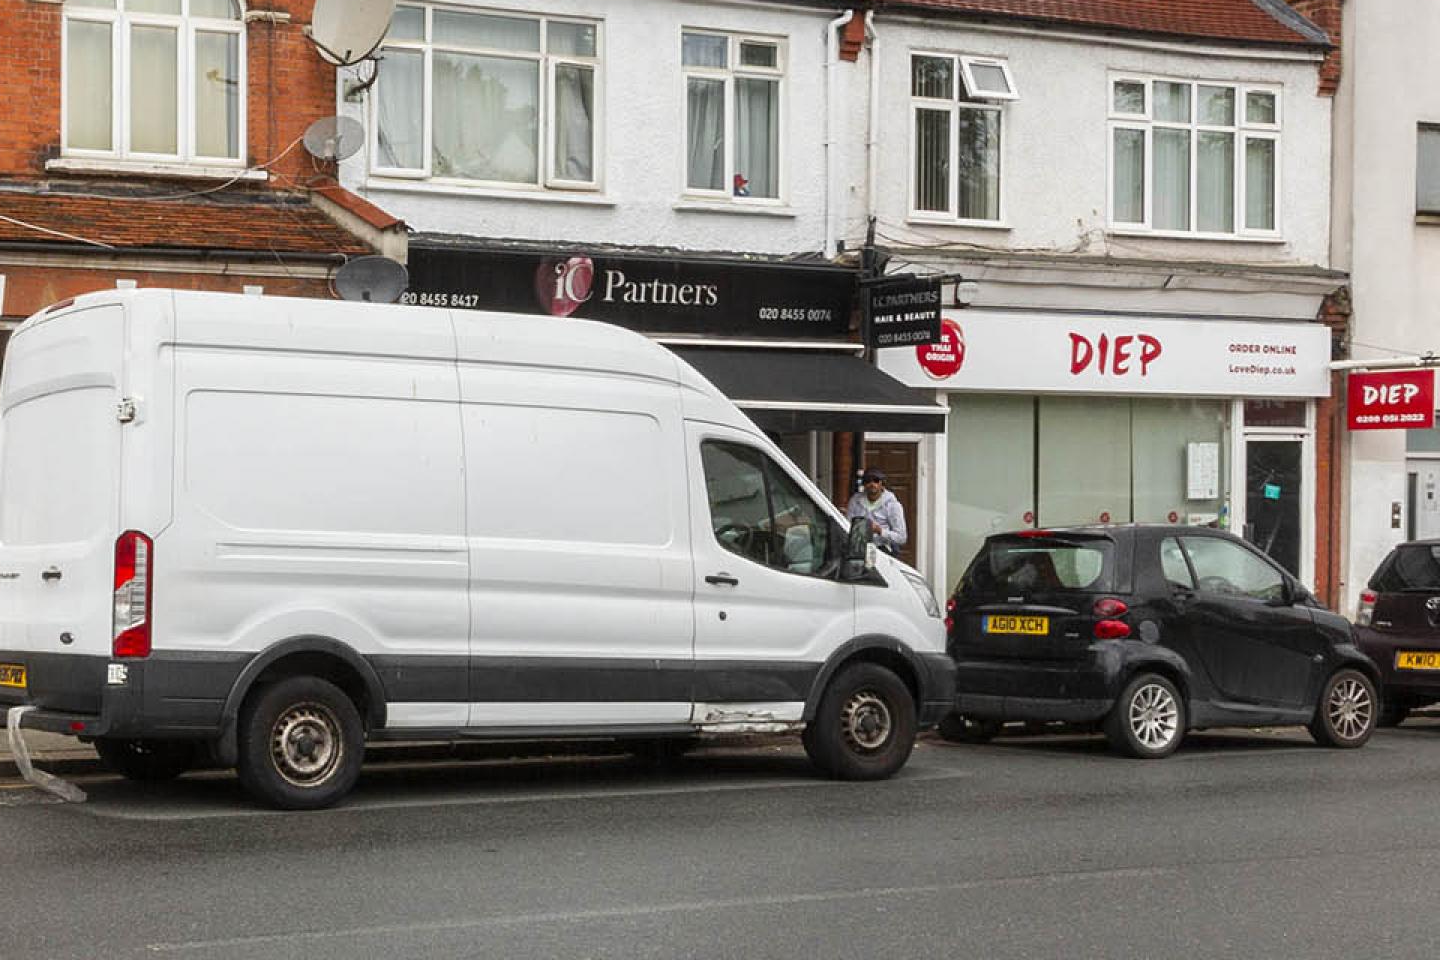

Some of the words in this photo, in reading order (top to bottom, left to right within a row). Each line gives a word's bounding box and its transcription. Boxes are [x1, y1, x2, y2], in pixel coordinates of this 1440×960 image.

[602, 269, 718, 306] Partners
[401, 292, 418, 304] 20
[420, 293, 448, 306] 8455
[451, 294, 479, 307] 8417
[759, 307, 779, 320] 020
[780, 308, 805, 321] 8455
[807, 309, 832, 321] 0074
[874, 314, 894, 324] HAIR
[896, 314, 903, 322] &
[904, 311, 936, 321] BEAUTY
[931, 344, 952, 352] THAI
[1068, 332, 1162, 376] DIEP
[1228, 343, 1261, 354] ORDER
[1262, 344, 1297, 355] ONLINE
[925, 352, 955, 362] ORIGIN
[1228, 363, 1297, 376] LoveDiep.co.uk
[1363, 383, 1420, 406] DIEP
[991, 617, 1017, 631] AG10
[1019, 617, 1044, 631] XCH
